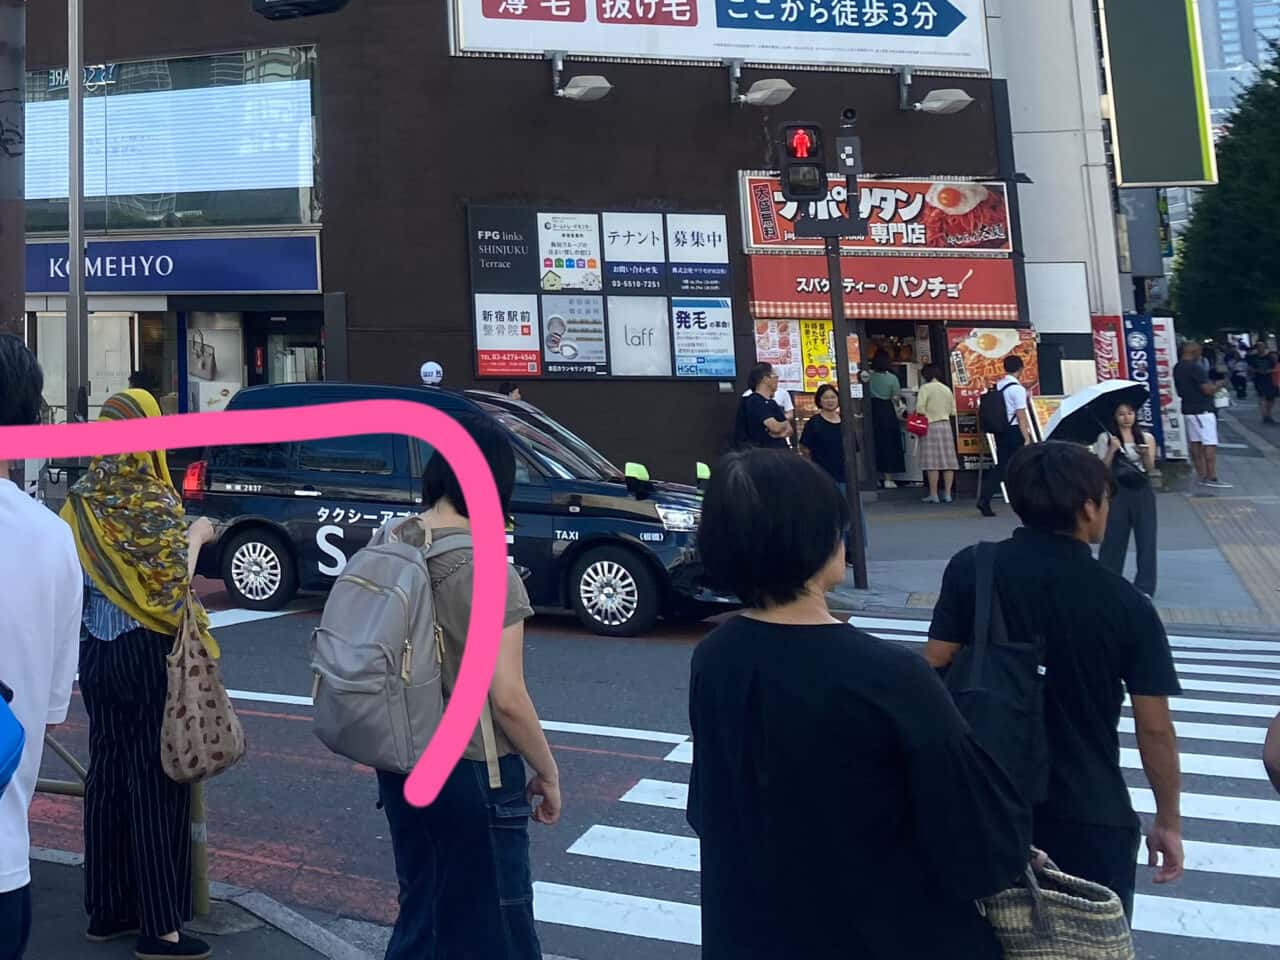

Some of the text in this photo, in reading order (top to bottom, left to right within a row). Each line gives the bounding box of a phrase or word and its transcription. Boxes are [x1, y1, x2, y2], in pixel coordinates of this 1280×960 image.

[478, 230, 500, 240] FPG
[608, 230, 660, 246] テナント
[674, 230, 722, 248] 募集中
[870, 222, 926, 244] 専門店
[479, 245, 528, 255] SHINJUKU
[481, 259, 511, 268] Terrace
[482, 310, 531, 322] 新宿駅前
[625, 323, 655, 347] laff
[1130, 350, 1150, 392] OSS
[555, 530, 579, 540] TAXI
